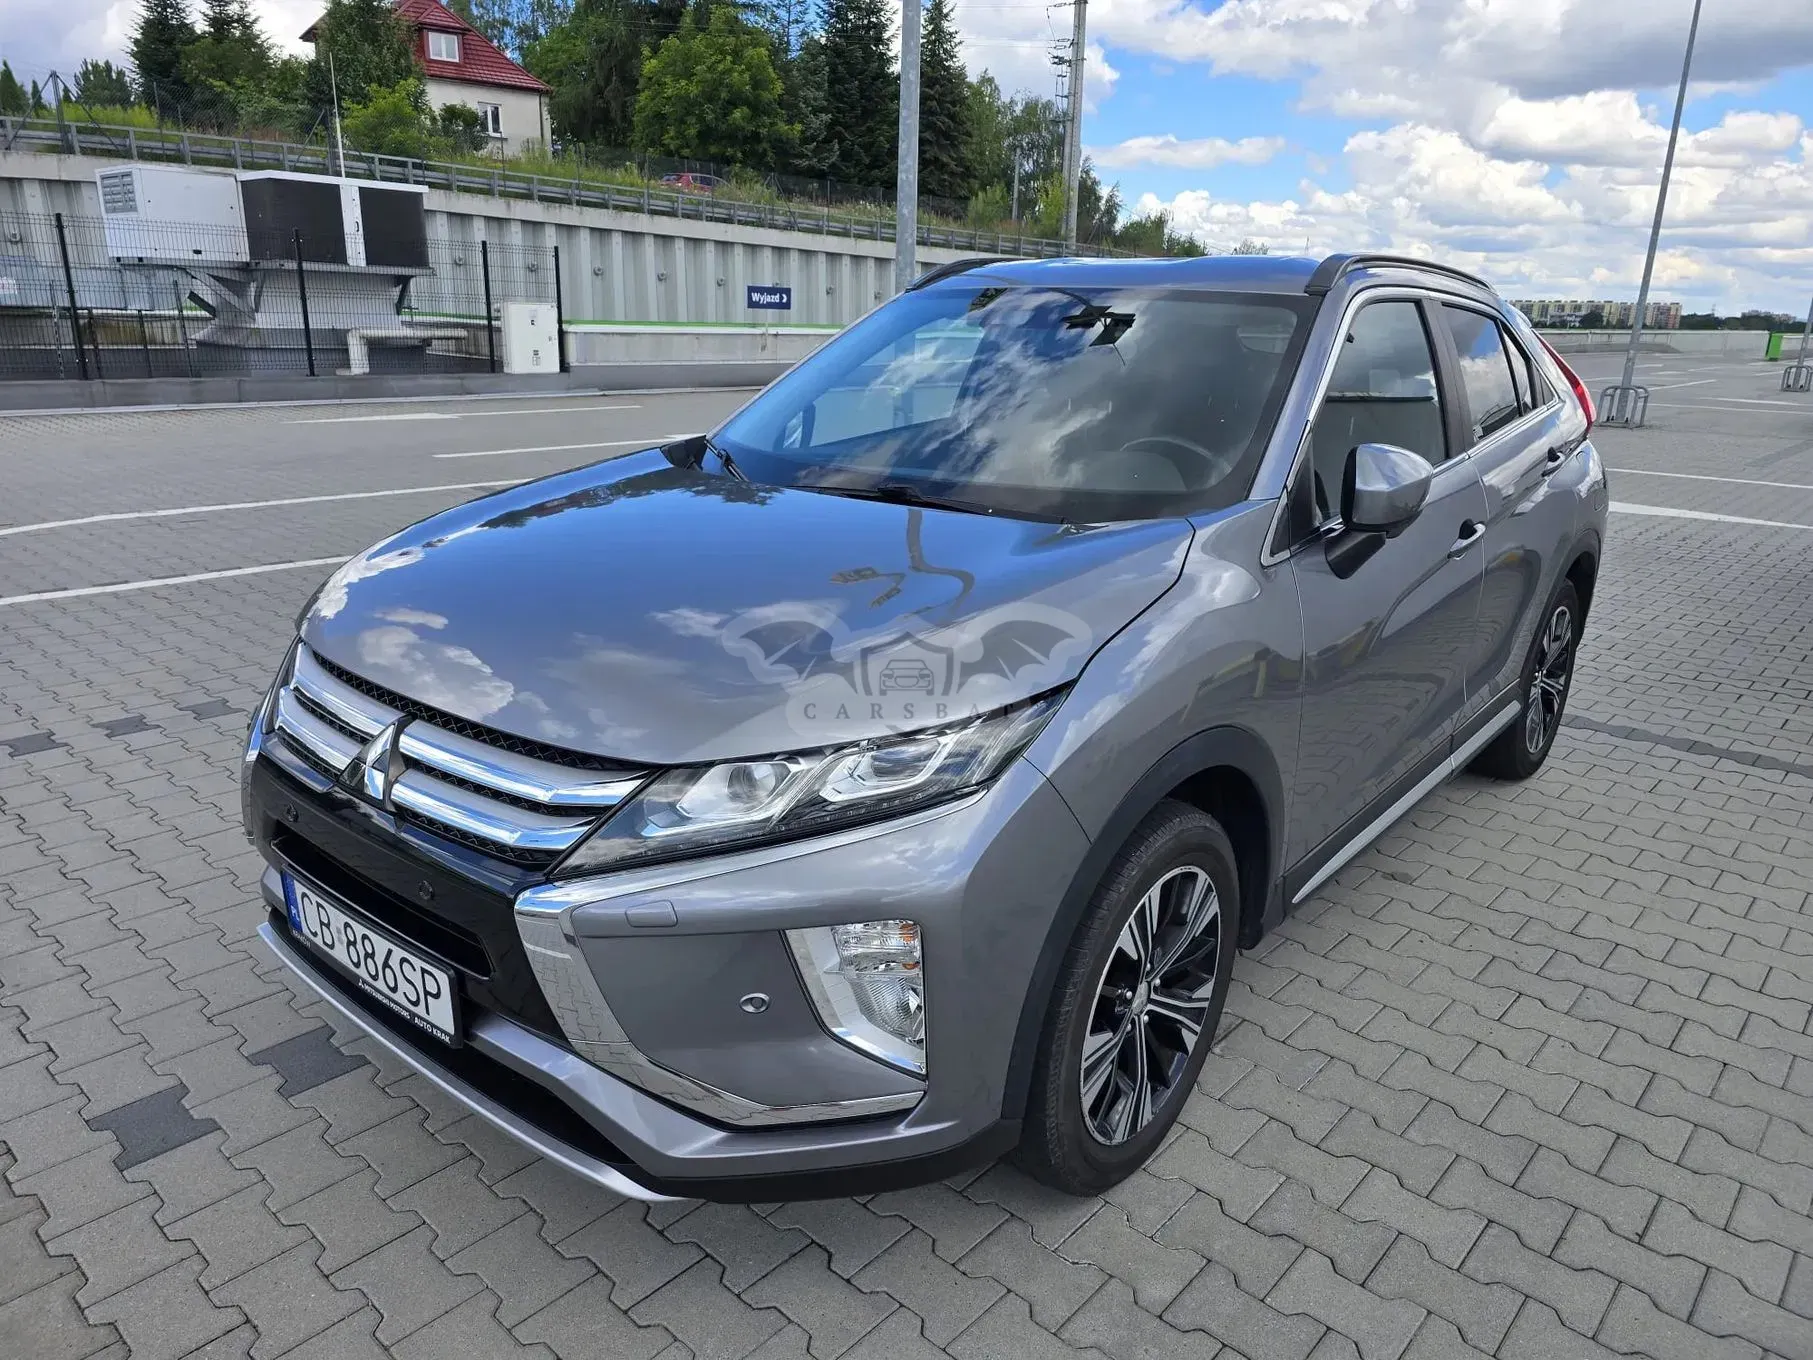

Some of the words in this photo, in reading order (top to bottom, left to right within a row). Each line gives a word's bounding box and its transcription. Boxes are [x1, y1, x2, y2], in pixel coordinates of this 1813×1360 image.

[751, 292, 780, 304] Wyjazd
[300, 891, 336, 951] CB
[343, 921, 442, 1017] 886SP
[414, 1016, 432, 1033] AUTO
